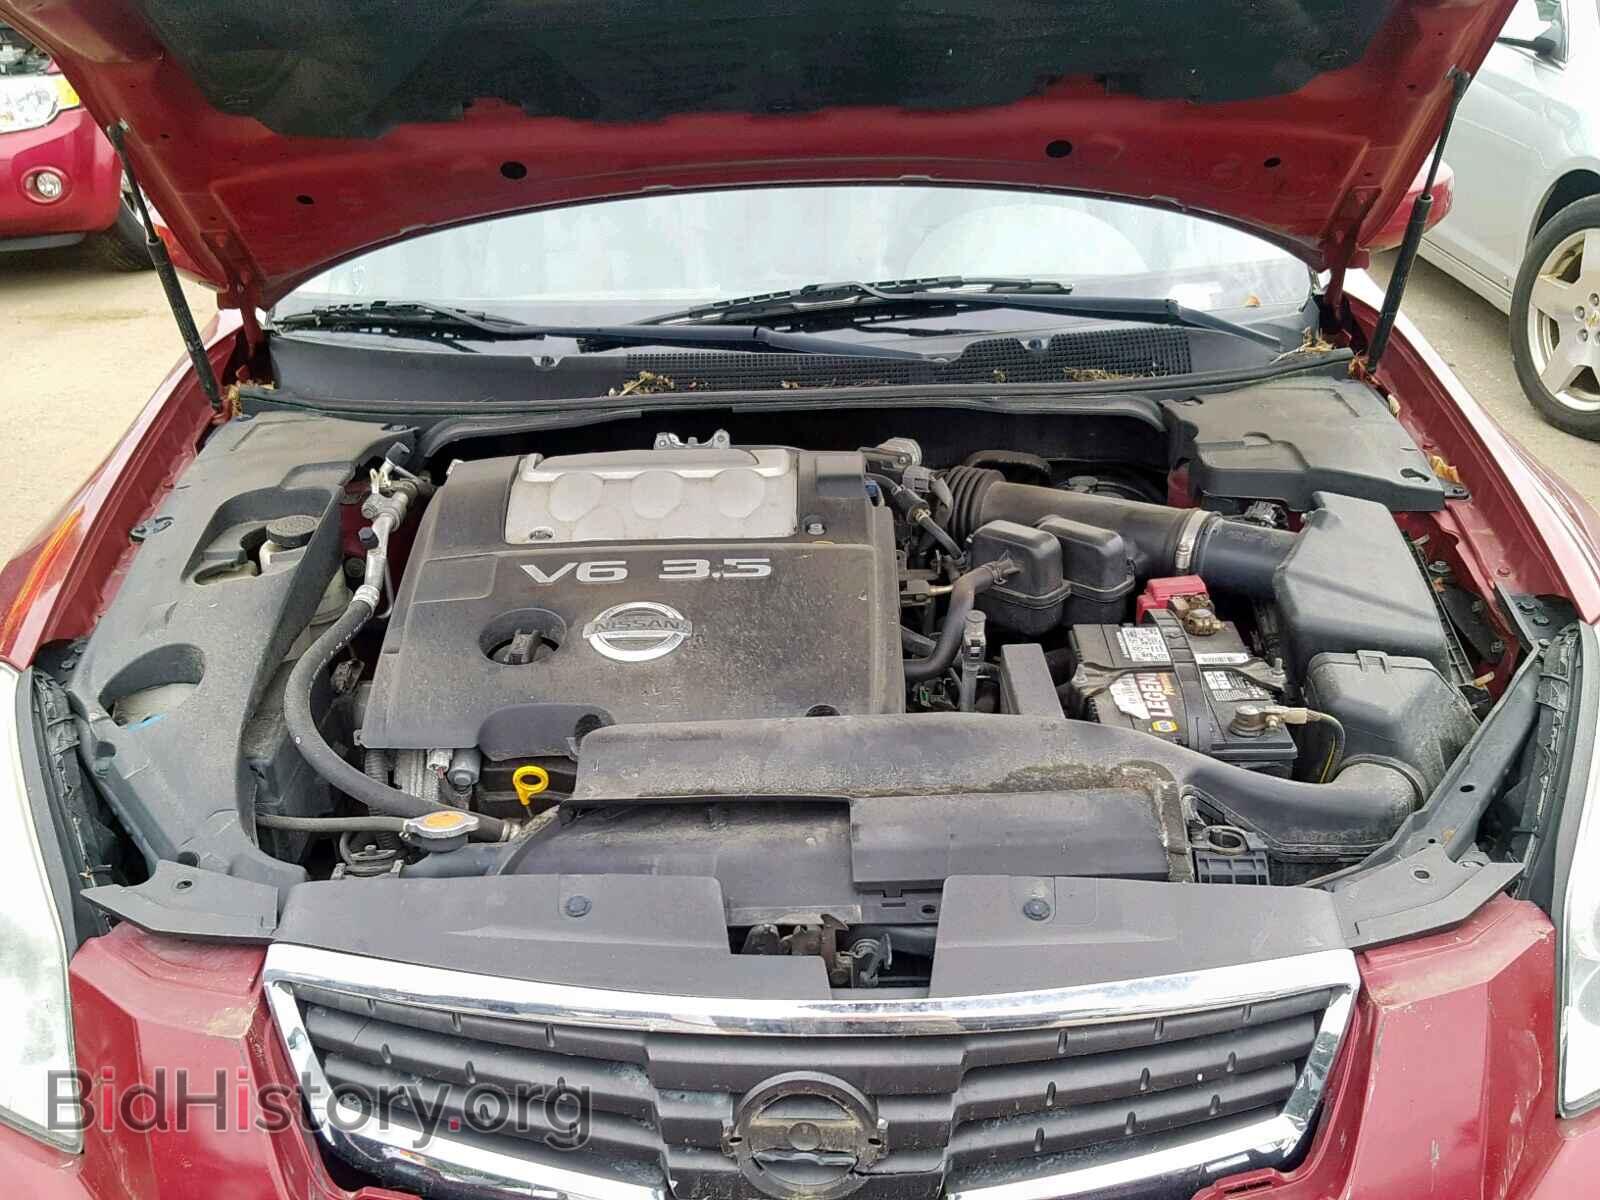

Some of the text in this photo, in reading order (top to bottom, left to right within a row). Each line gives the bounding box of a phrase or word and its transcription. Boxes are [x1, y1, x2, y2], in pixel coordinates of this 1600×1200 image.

[519, 558, 772, 584] V6 3.5
[594, 619, 680, 633] NISSAN
[1135, 671, 1174, 718] LEGEN
